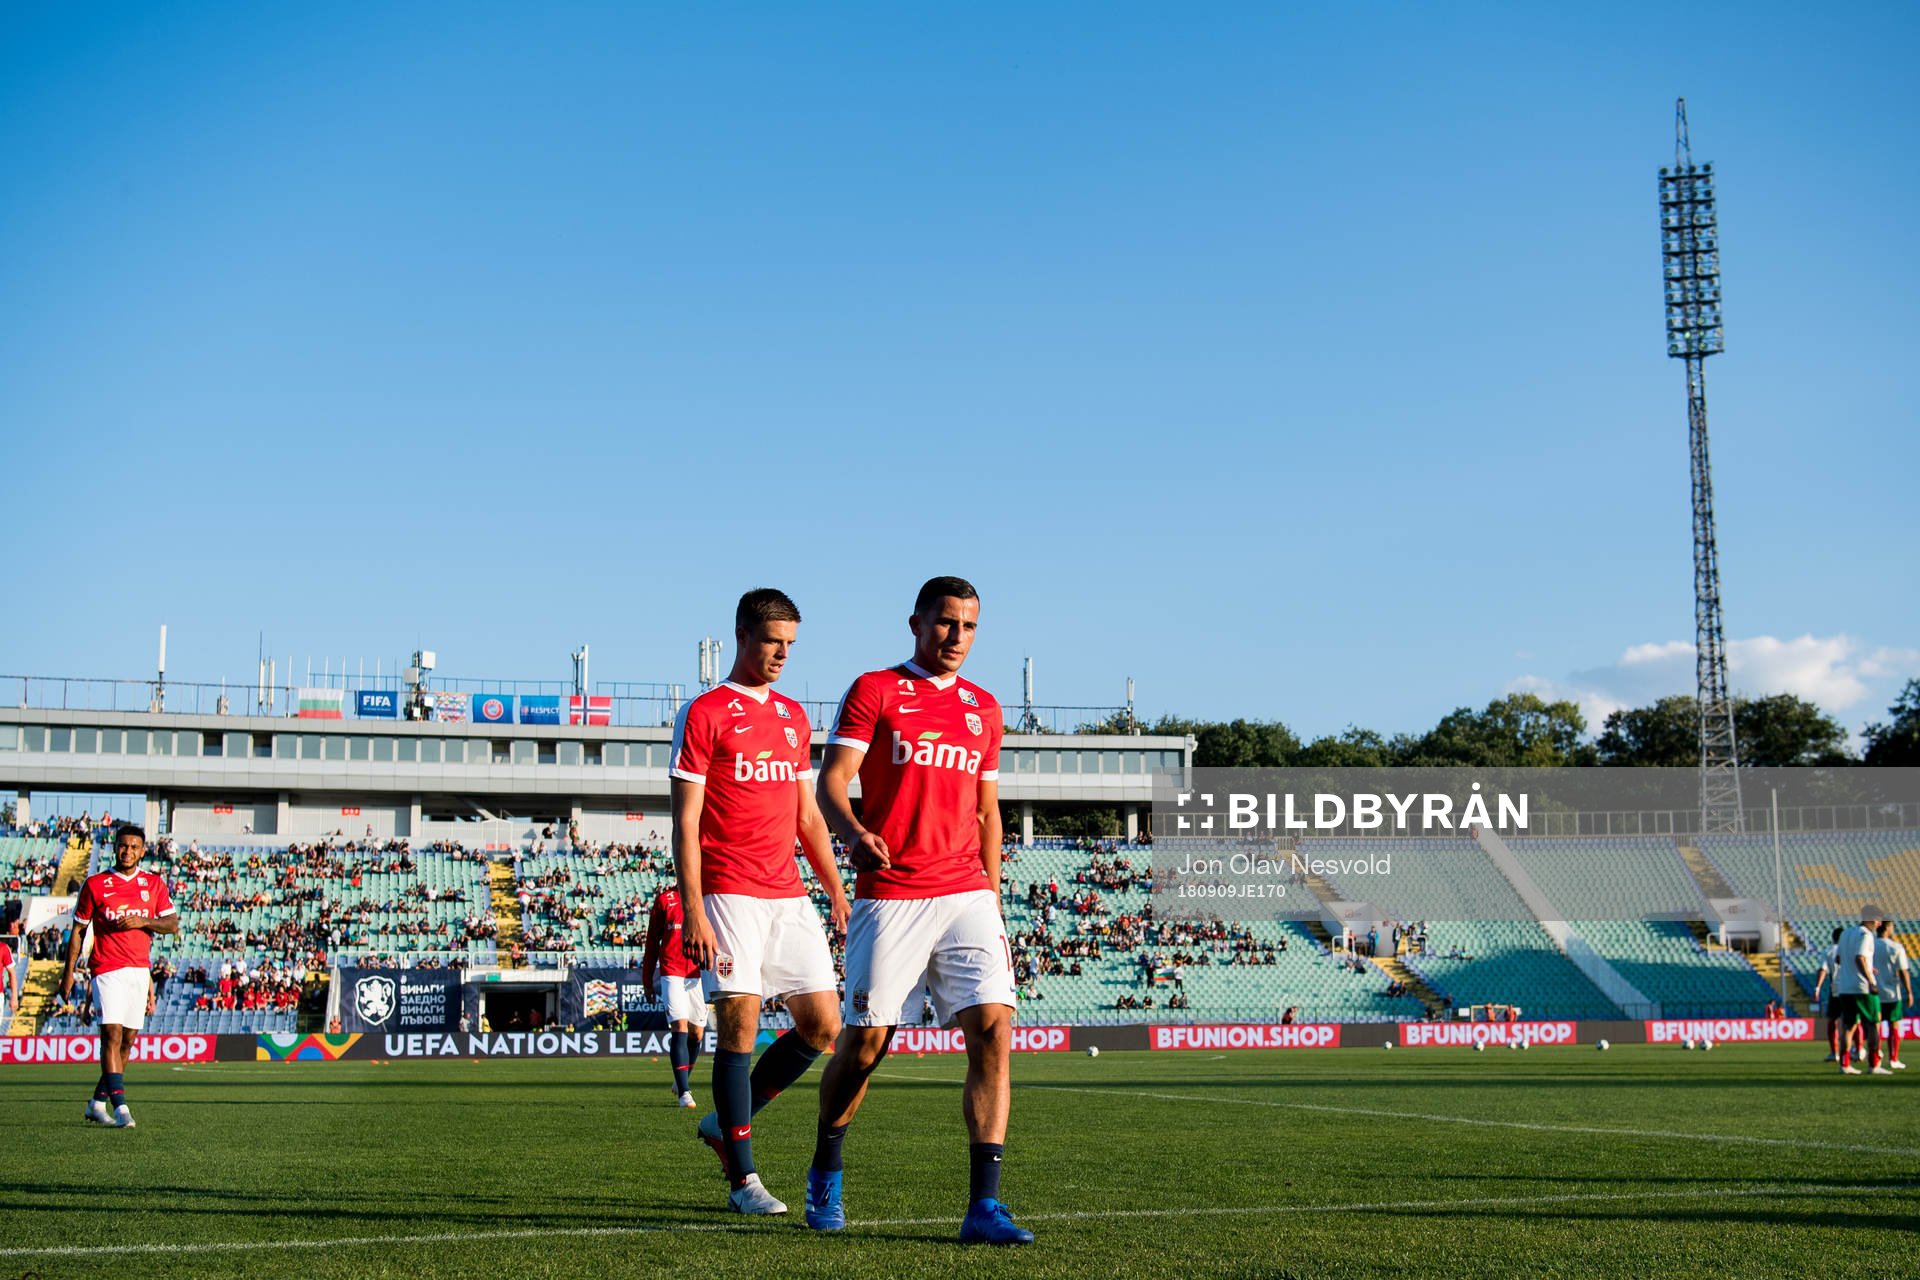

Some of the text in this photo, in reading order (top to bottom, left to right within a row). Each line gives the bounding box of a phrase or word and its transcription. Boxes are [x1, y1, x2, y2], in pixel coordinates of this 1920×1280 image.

[363, 695, 391, 707] FIFA
[892, 731, 982, 774] bama
[400, 984, 445, 995] ВИНАГИ
[400, 994, 446, 1006] ЗАЕДНО
[400, 1005, 445, 1015] ВИНАГИ
[400, 1015, 446, 1025] ЛЪВОВЕ
[1157, 1026, 1334, 1048] BFUNION.SHOP
[1406, 1023, 1571, 1045] BFUNION.SHOP
[1652, 1020, 1809, 1041] BFUNION.SHOP
[385, 1032, 717, 1056] UEFA NATIONS LEAE
